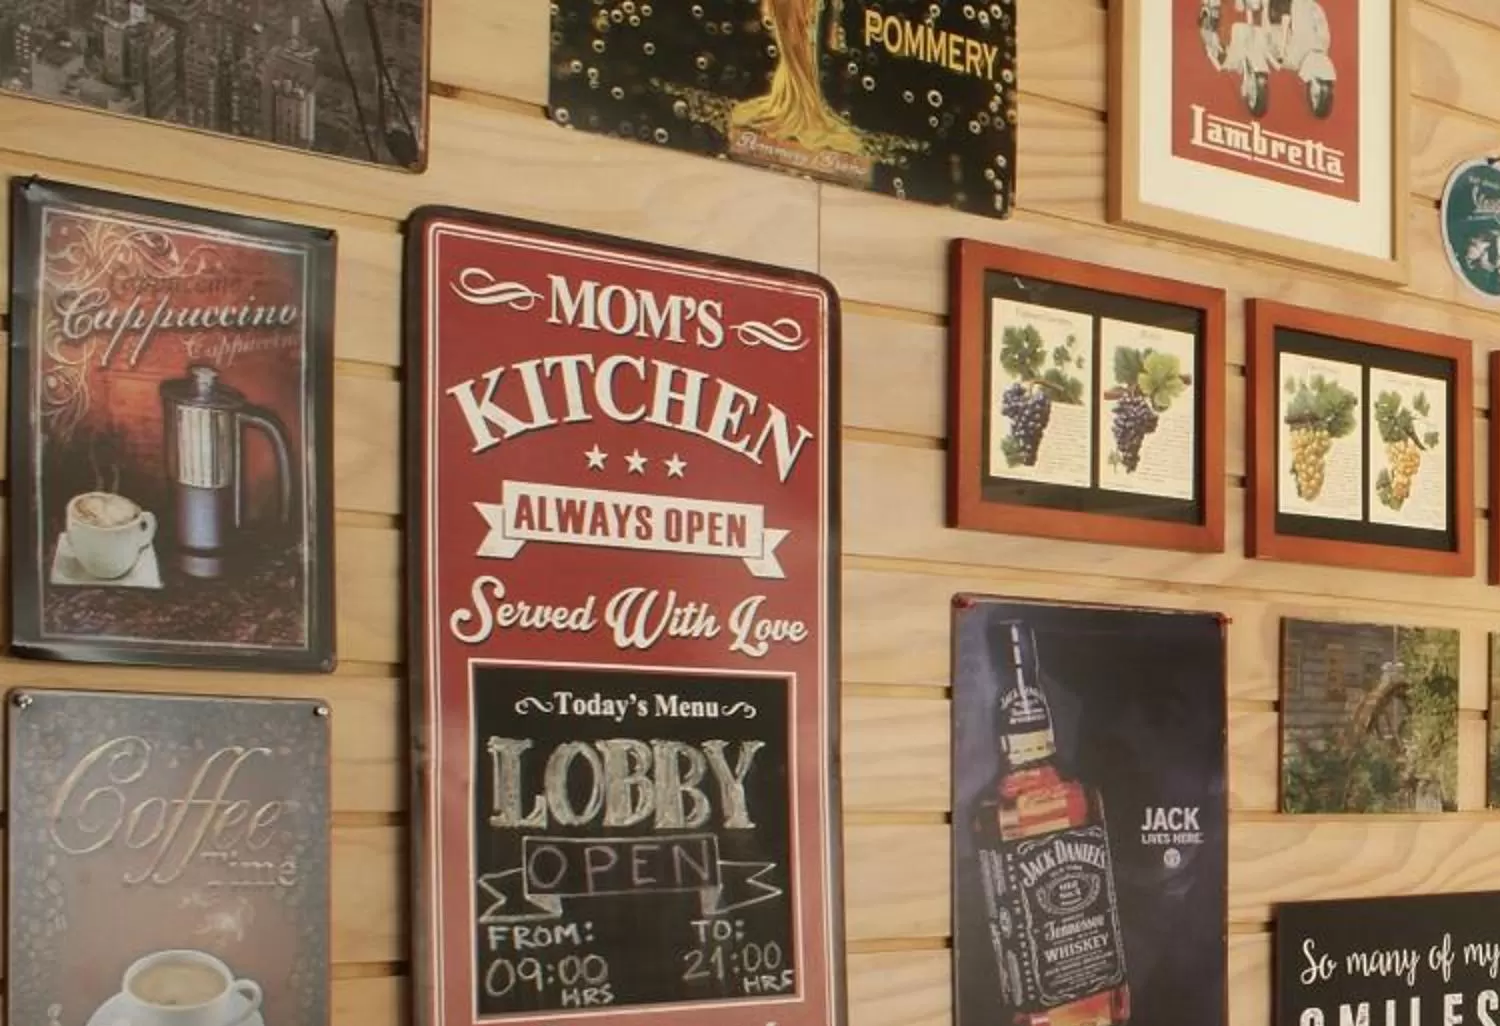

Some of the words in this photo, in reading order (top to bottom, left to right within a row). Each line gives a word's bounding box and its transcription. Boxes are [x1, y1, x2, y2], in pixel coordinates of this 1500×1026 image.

[863, 9, 999, 81] POMMERY
[1189, 103, 1345, 179] Lambretta
[55, 287, 298, 368] Cappuccino
[546, 273, 725, 349] MOM'S
[446, 353, 814, 483] KITCHEN
[514, 494, 654, 541] ALWAYS
[665, 508, 747, 548] OPEN
[450, 575, 597, 644] Served
[604, 586, 721, 650] With
[728, 595, 809, 658] Love
[552, 690, 648, 722] Today's
[655, 694, 720, 719] Menu
[487, 735, 766, 829] LOBBY
[50, 735, 282, 884] Coffee
[1141, 806, 1200, 832] JACK
[1141, 833, 1171, 845] LIVES
[528, 840, 710, 894] OPEN
[1019, 847, 1057, 888] JACK
[487, 921, 595, 951] FROM:
[690, 919, 745, 943] TO:
[1043, 931, 1109, 963] WHISKEY
[485, 953, 608, 996] 09:00
[683, 942, 782, 981] 21:00
[743, 969, 795, 992] HRS
[1300, 937, 1337, 985] So
[1346, 948, 1420, 987] many
[1428, 931, 1455, 983] of
[561, 987, 615, 1006] HRS
